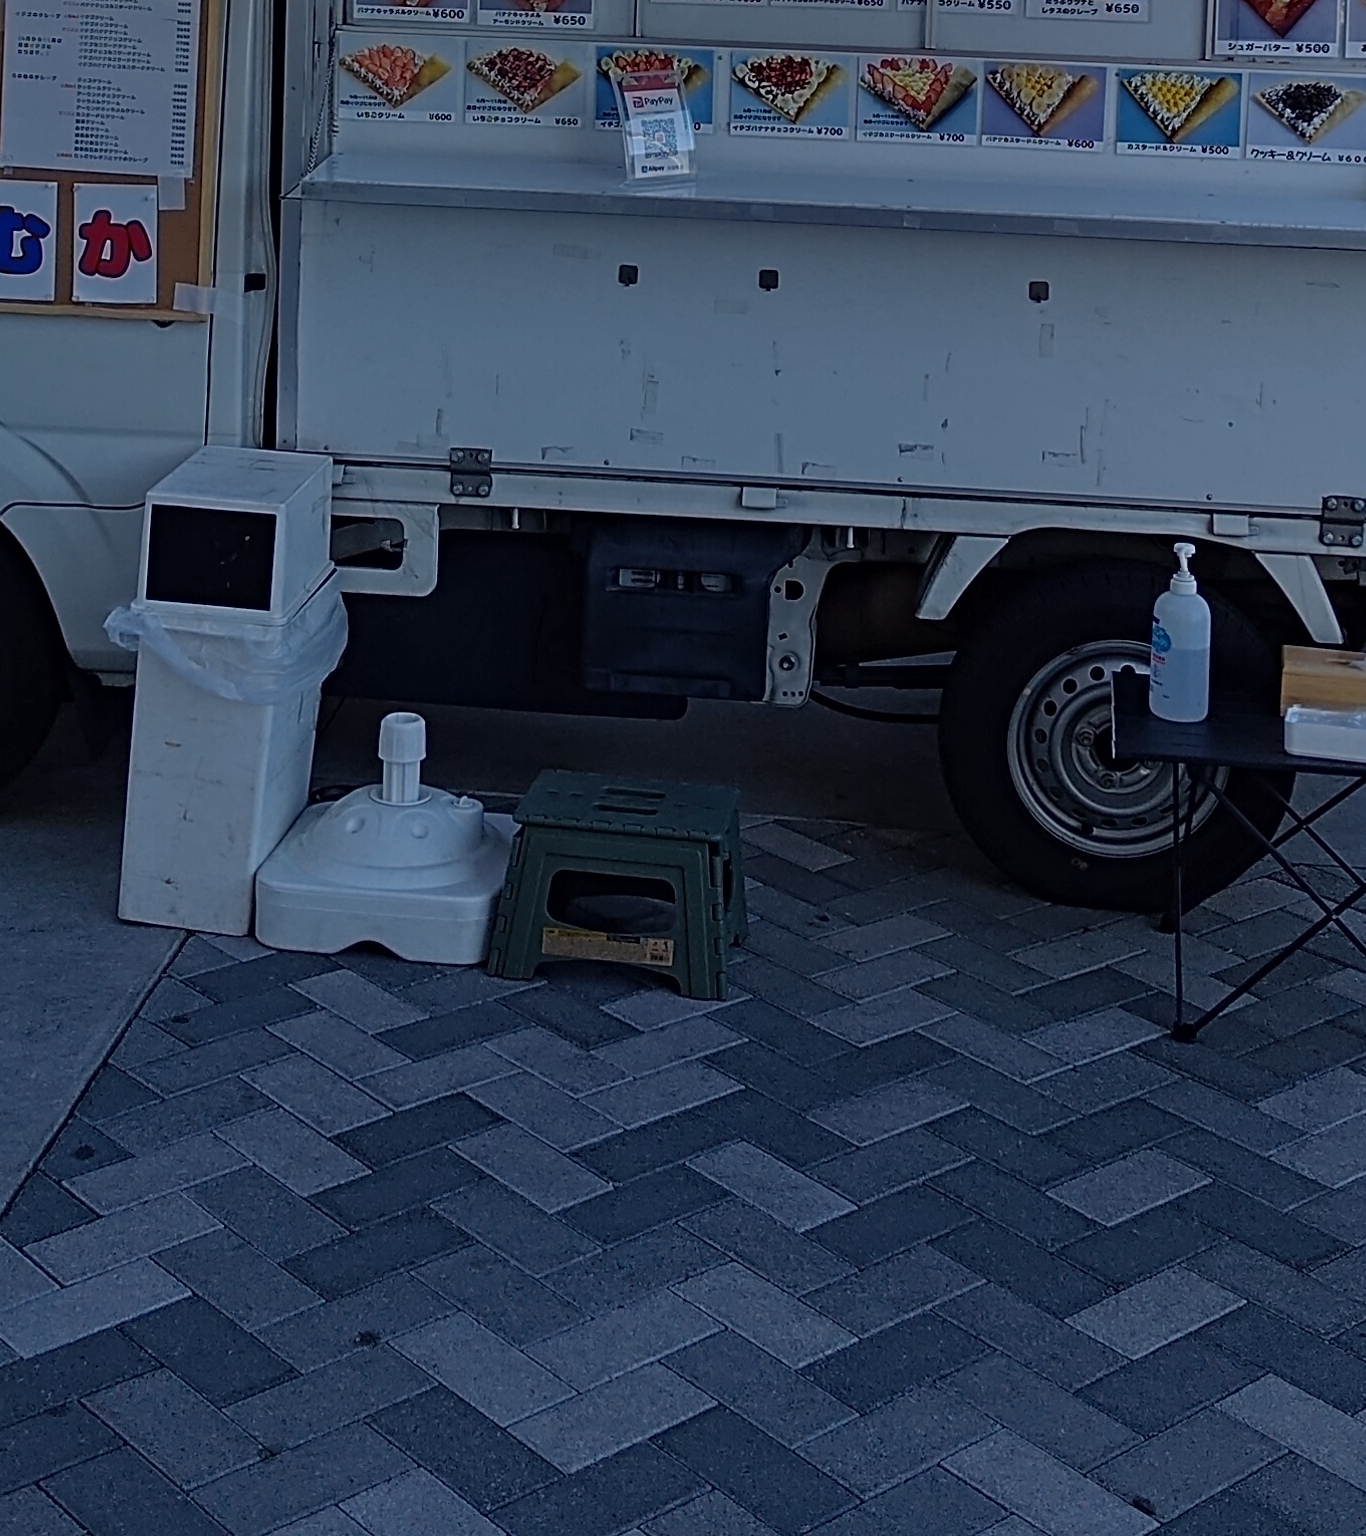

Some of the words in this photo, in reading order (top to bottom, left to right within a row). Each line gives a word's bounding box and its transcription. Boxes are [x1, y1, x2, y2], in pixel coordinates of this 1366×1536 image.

[978, 0, 1012, 10] ¥550
[1105, 3, 1140, 14] ¥650
[432, 9, 465, 19] ¥600
[553, 15, 586, 26] ¥650
[1228, 42, 1290, 52] シュガーバター
[1296, 43, 1330, 54] ¥500
[644, 96, 673, 107] PayPay
[356, 111, 405, 119] いちごクリーム
[428, 113, 452, 122] ¥600
[472, 115, 541, 125] いちごチョコクリーム
[555, 117, 578, 126] ¥650
[816, 126, 843, 136] ¥700
[939, 133, 965, 142] ¥700
[1067, 139, 1095, 149] ¥600
[1201, 146, 1229, 155] ¥500
